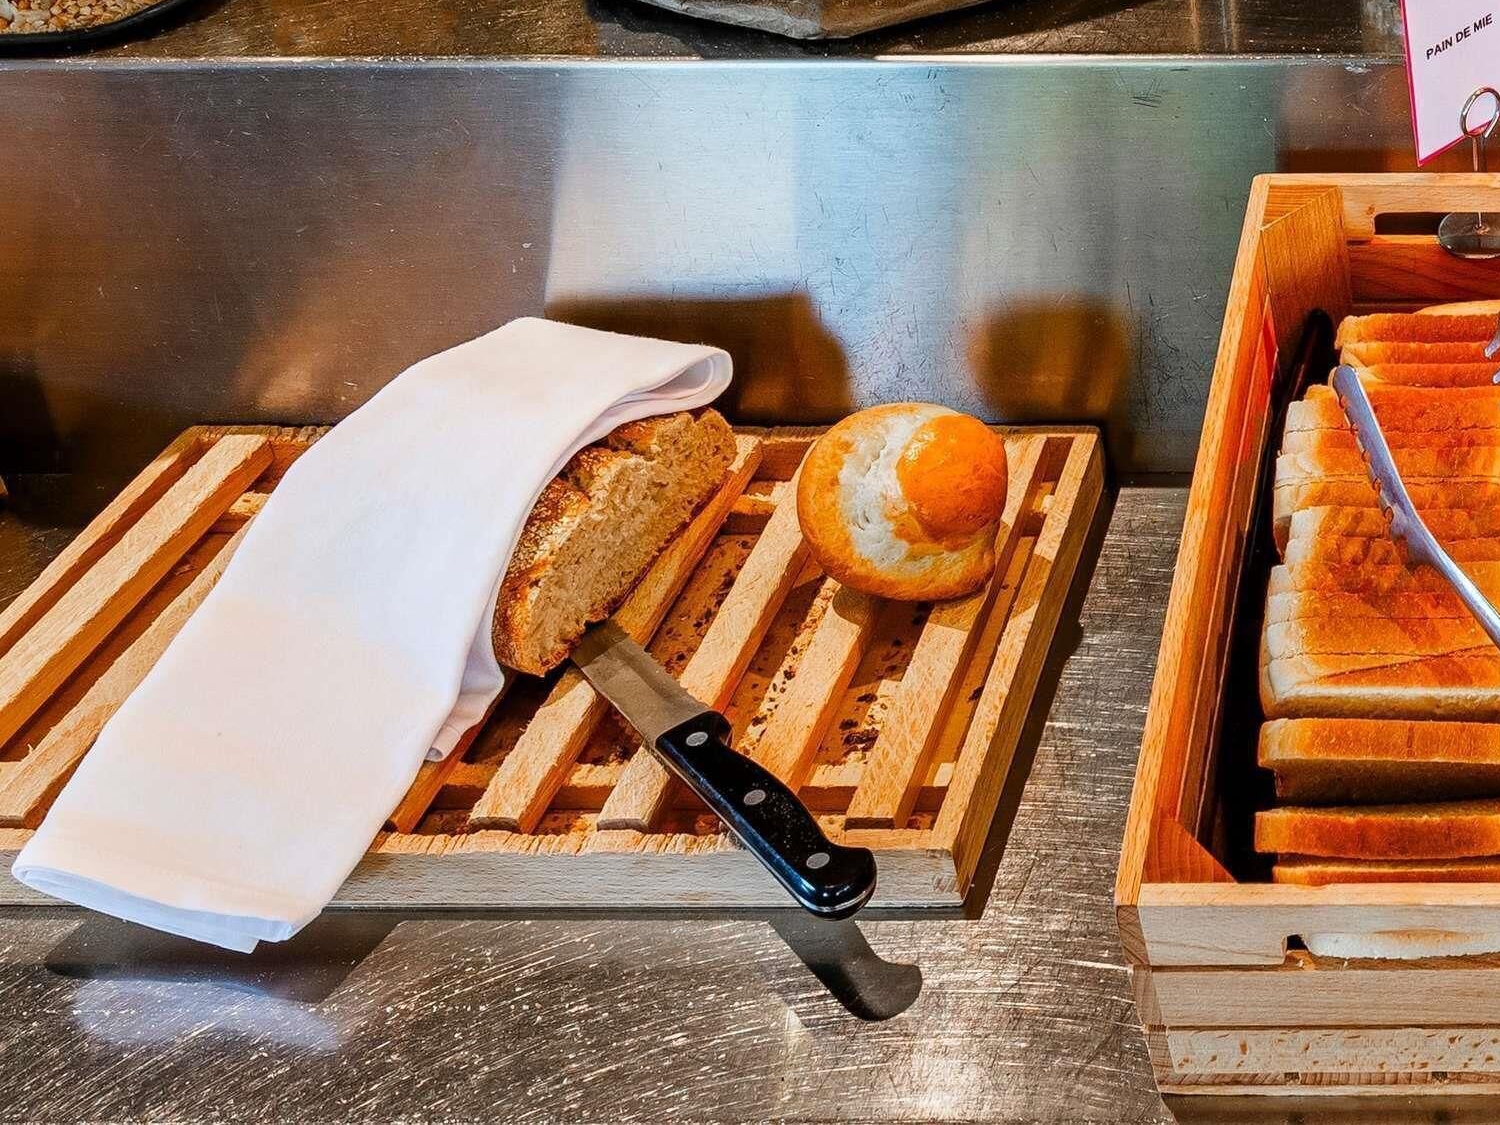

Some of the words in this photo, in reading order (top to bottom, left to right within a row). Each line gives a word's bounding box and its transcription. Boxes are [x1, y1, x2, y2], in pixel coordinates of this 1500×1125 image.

[1425, 35, 1453, 60] PAIN
[1455, 25, 1472, 45] DE
[1473, 13, 1493, 33] MIE
